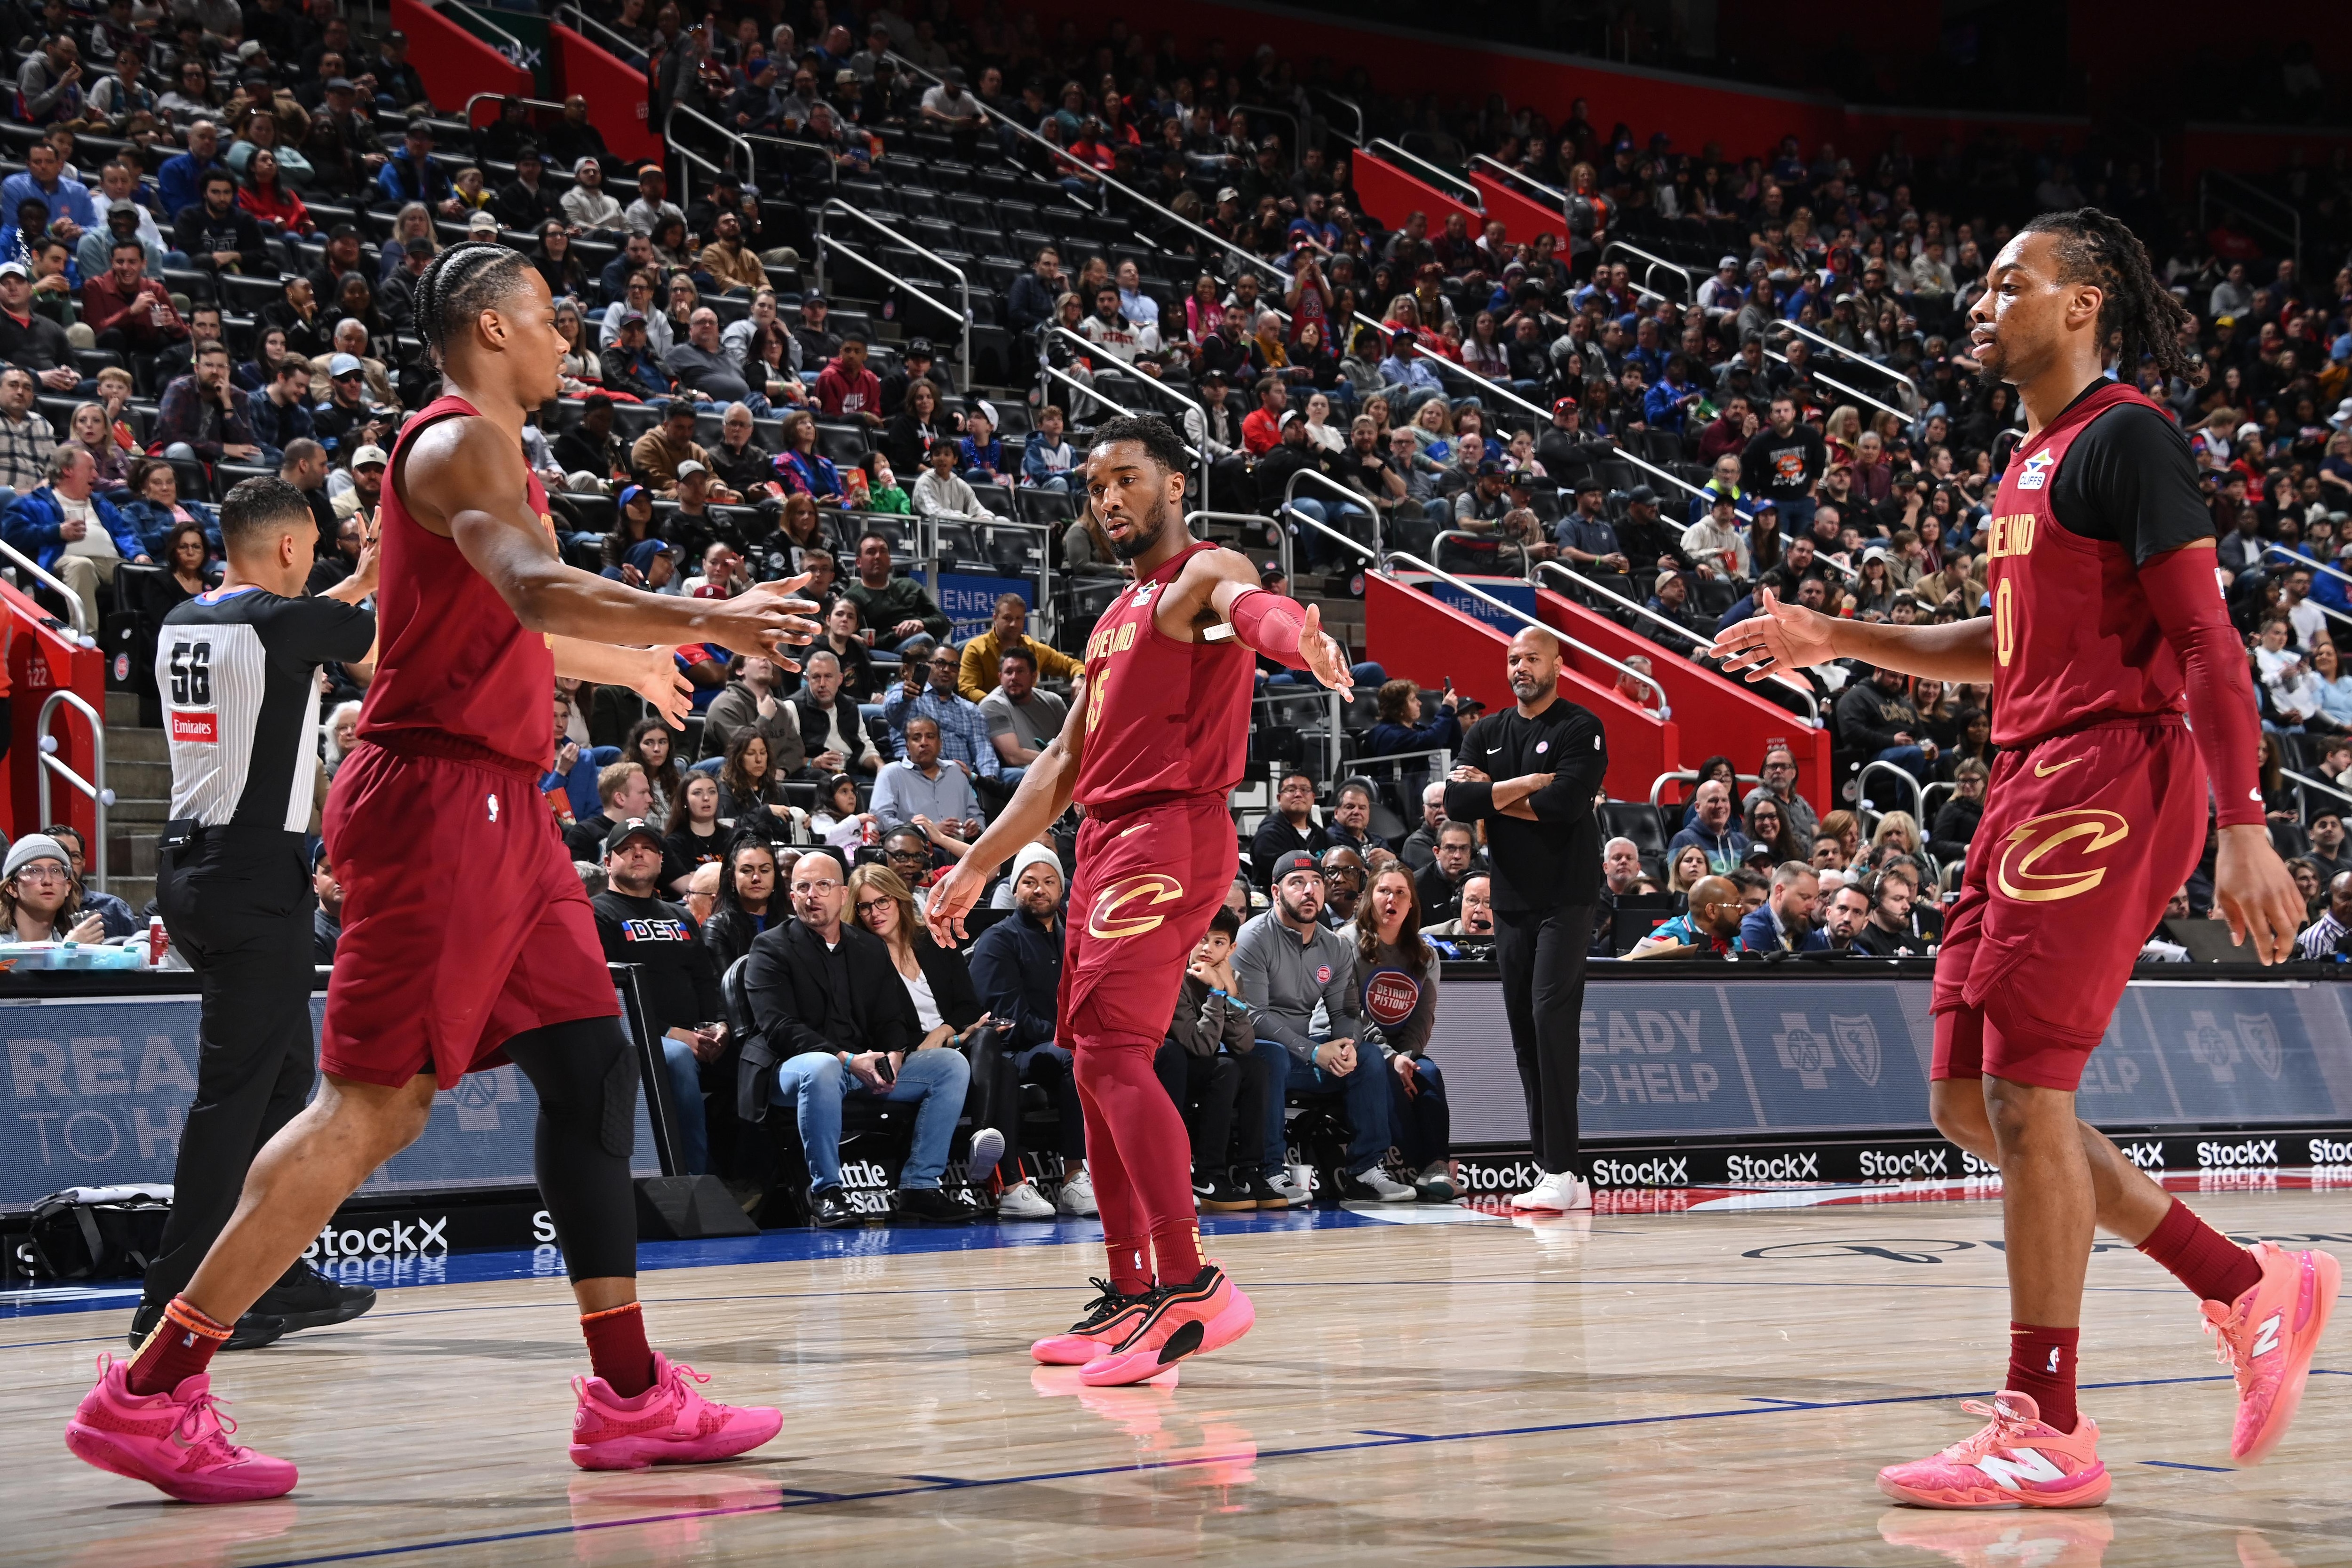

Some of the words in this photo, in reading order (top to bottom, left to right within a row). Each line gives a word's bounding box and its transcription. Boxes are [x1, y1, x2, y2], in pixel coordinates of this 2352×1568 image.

[2019, 476, 2043, 486] CLIFFS
[1996, 577, 2014, 667] 0
[27, 666, 48, 687] 122
[170, 642, 211, 704] 56
[174, 719, 212, 734] Emirates
[626, 918, 683, 942] DET
[1373, 993, 1411, 1011] PISTONS
[1376, 983, 1413, 1001] DETROIT
[1579, 1010, 1702, 1054] EADY
[7, 1036, 199, 1097] REA
[2080, 1057, 2141, 1094] ELP
[1610, 1063, 1719, 1103] HELP
[20, 1109, 119, 1165] TO
[2308, 1138, 2352, 1163] Stoc
[1726, 1152, 1819, 1180] StockX
[1859, 1148, 1948, 1177] StockX
[2196, 1139, 2279, 1167] StockX
[1592, 1156, 1689, 1186] StockX
